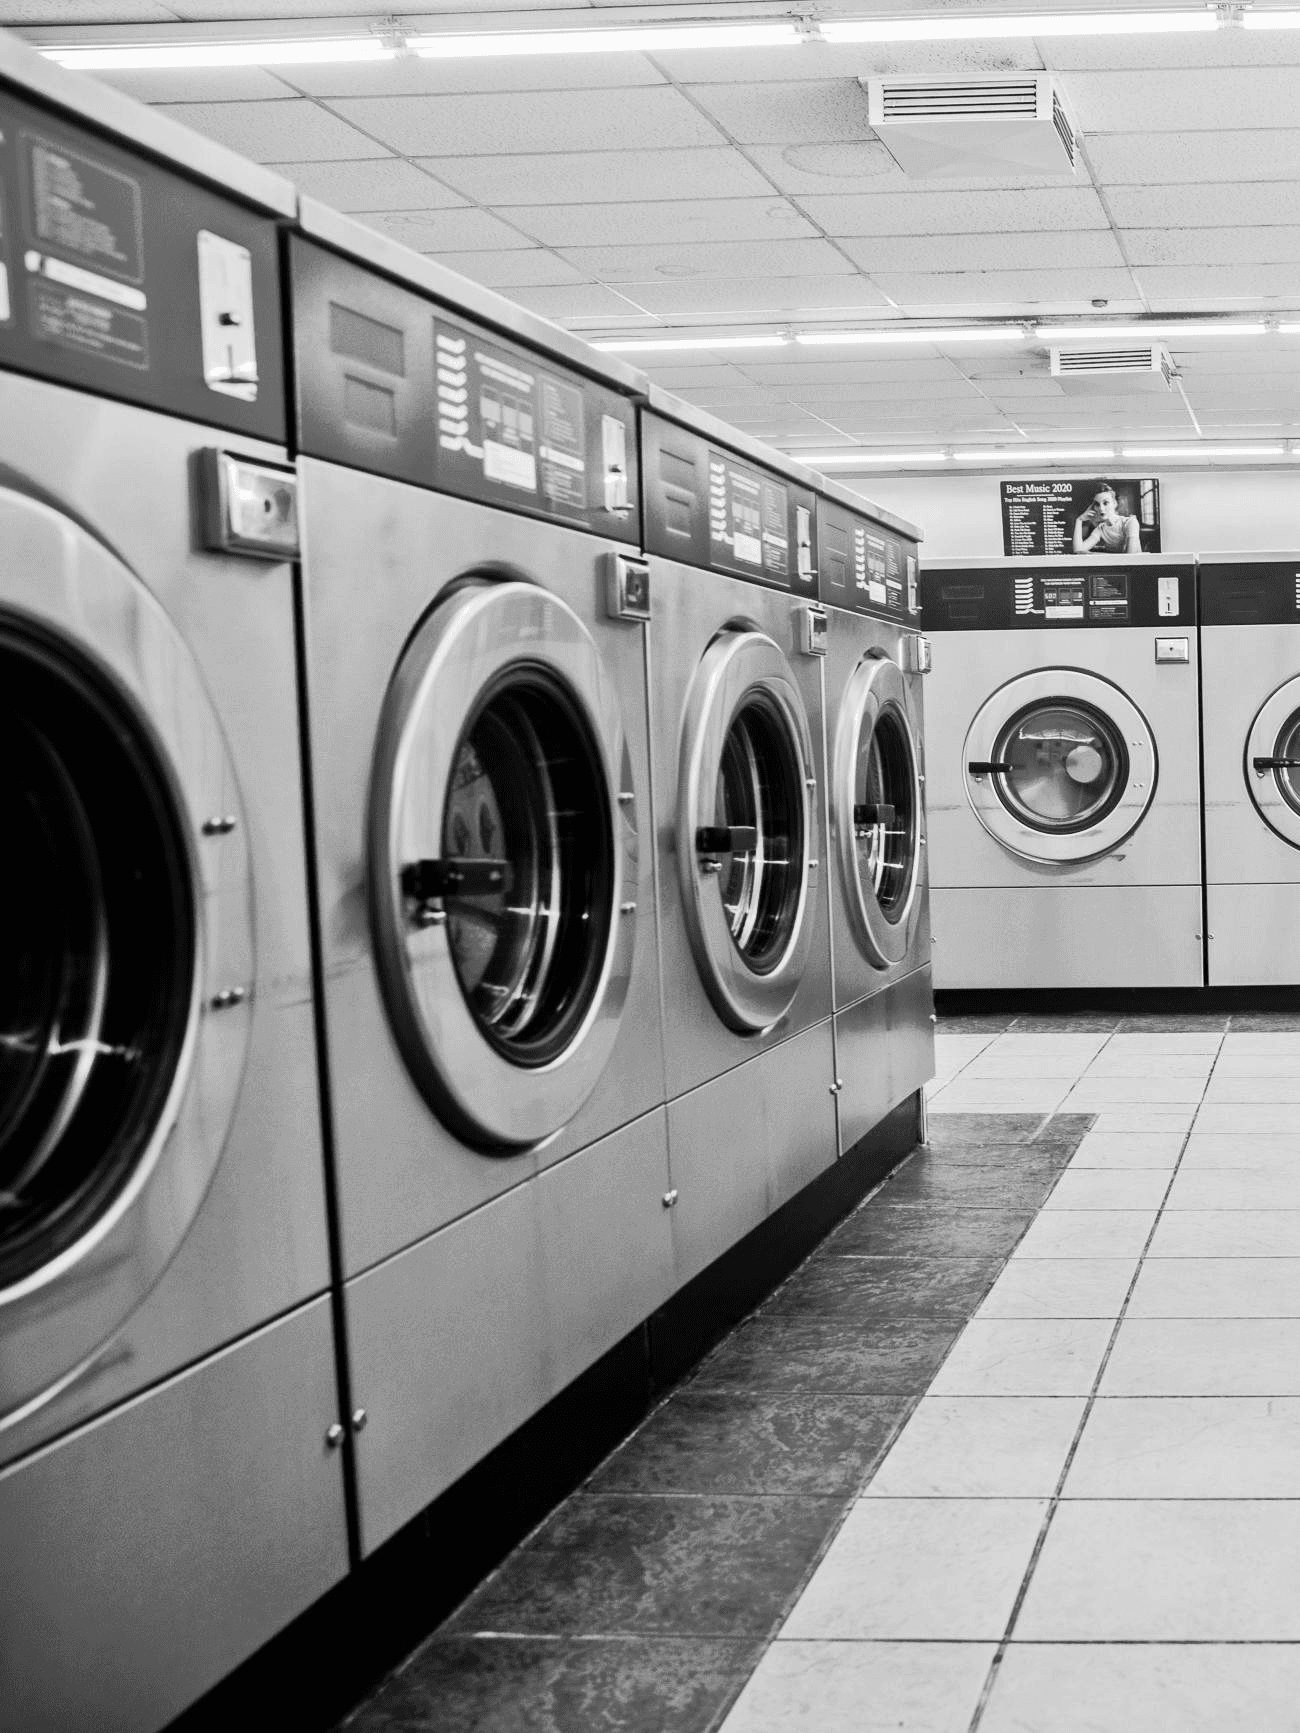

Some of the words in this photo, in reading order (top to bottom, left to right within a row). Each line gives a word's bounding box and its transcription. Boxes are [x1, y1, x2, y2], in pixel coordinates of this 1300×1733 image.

[1006, 484, 1024, 494] Best
[1026, 484, 1050, 493] Music
[1052, 483, 1073, 493] 2020
